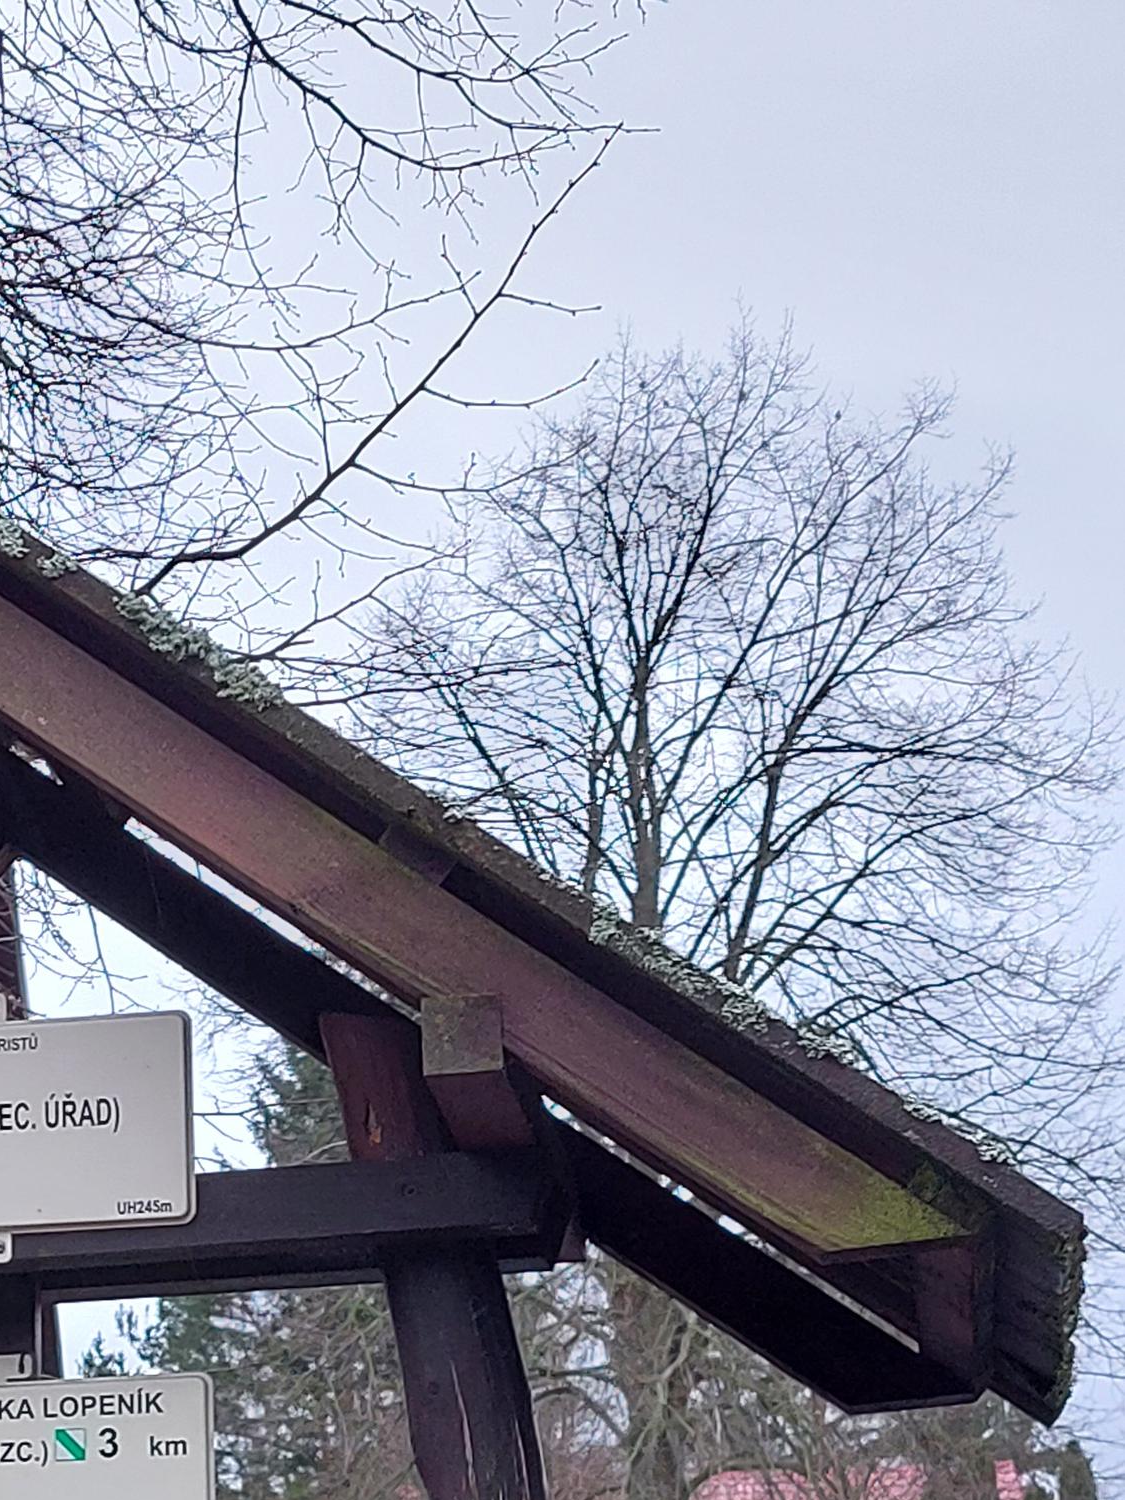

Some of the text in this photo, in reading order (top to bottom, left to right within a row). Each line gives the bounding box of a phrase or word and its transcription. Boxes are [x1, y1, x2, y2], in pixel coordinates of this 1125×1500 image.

[44, 1092, 121, 1133] ÚŘAD)
[117, 1200, 173, 1215] UH245m
[43, 1388, 163, 1419] LOPENÍK
[99, 1428, 119, 1459] 3
[149, 1434, 187, 1456] km
